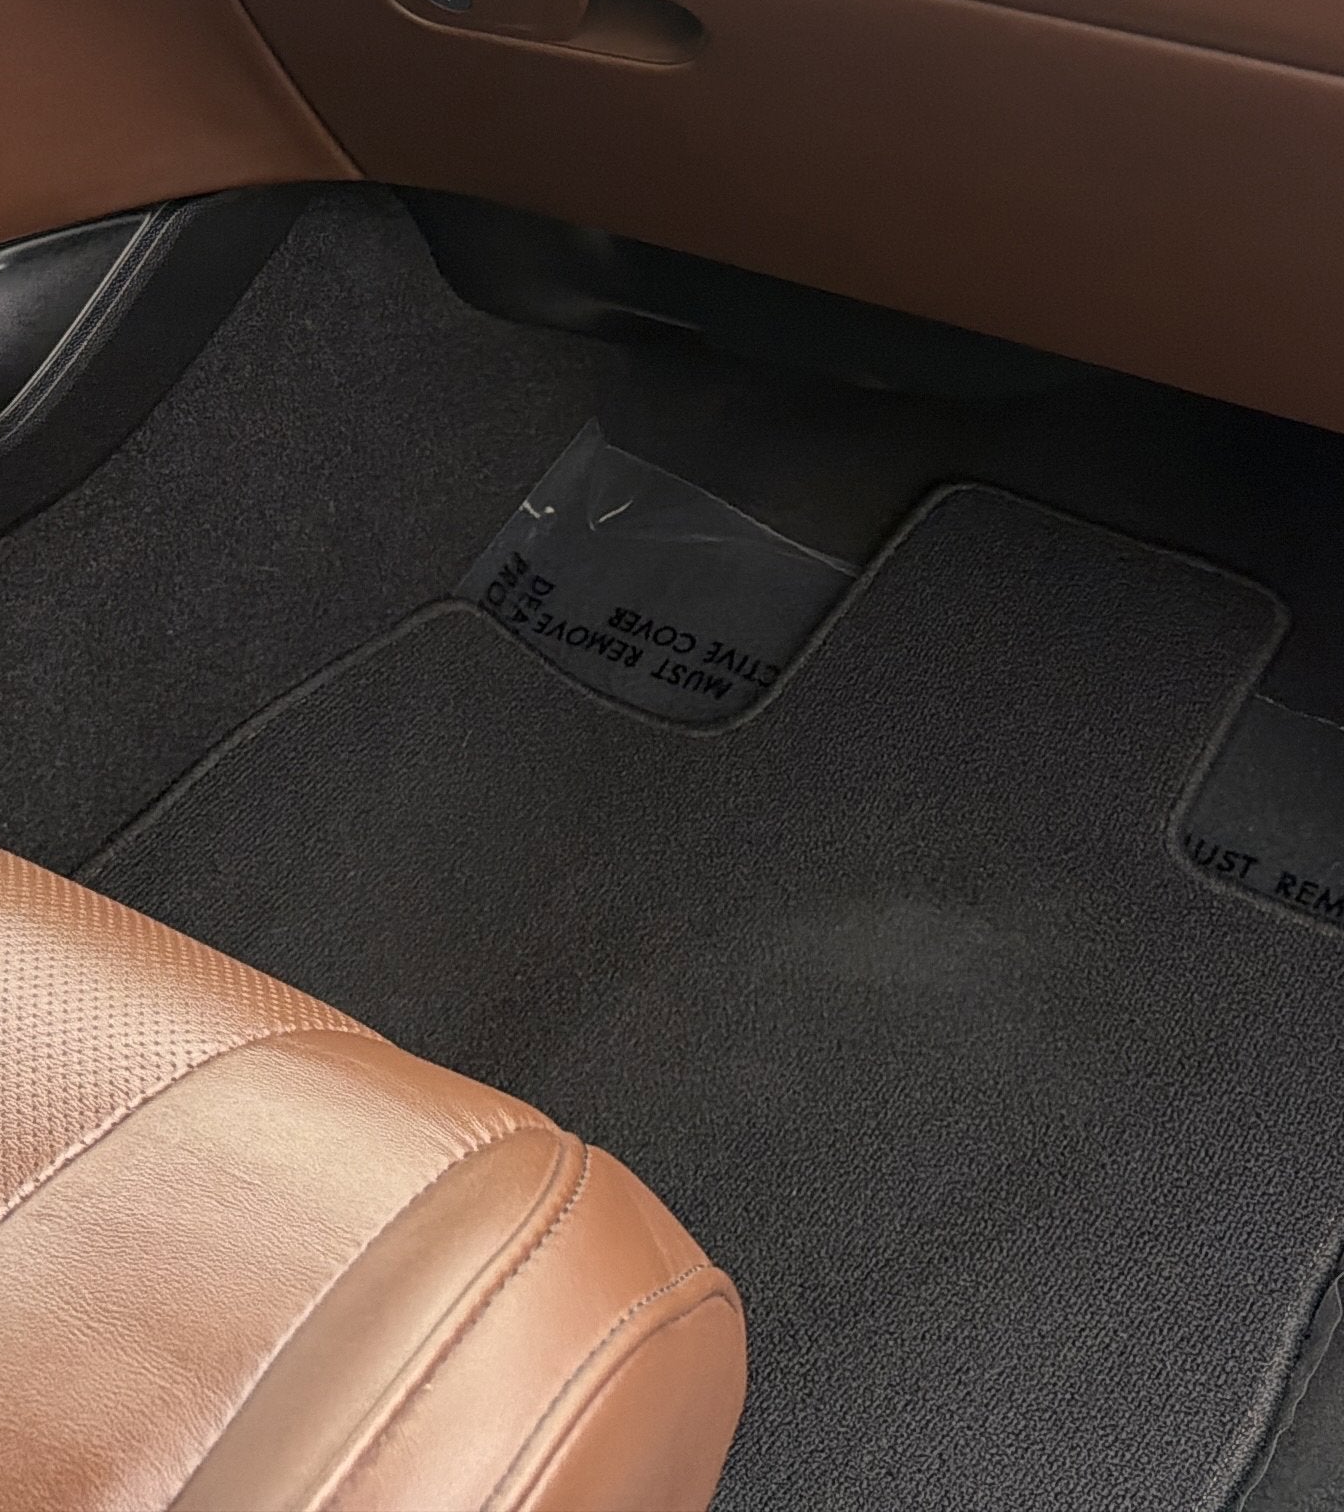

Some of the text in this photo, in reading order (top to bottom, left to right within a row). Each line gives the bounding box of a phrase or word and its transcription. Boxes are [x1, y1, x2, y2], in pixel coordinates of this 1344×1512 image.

[532, 613, 733, 700] MUST REMOVE
[606, 606, 697, 655] COVER
